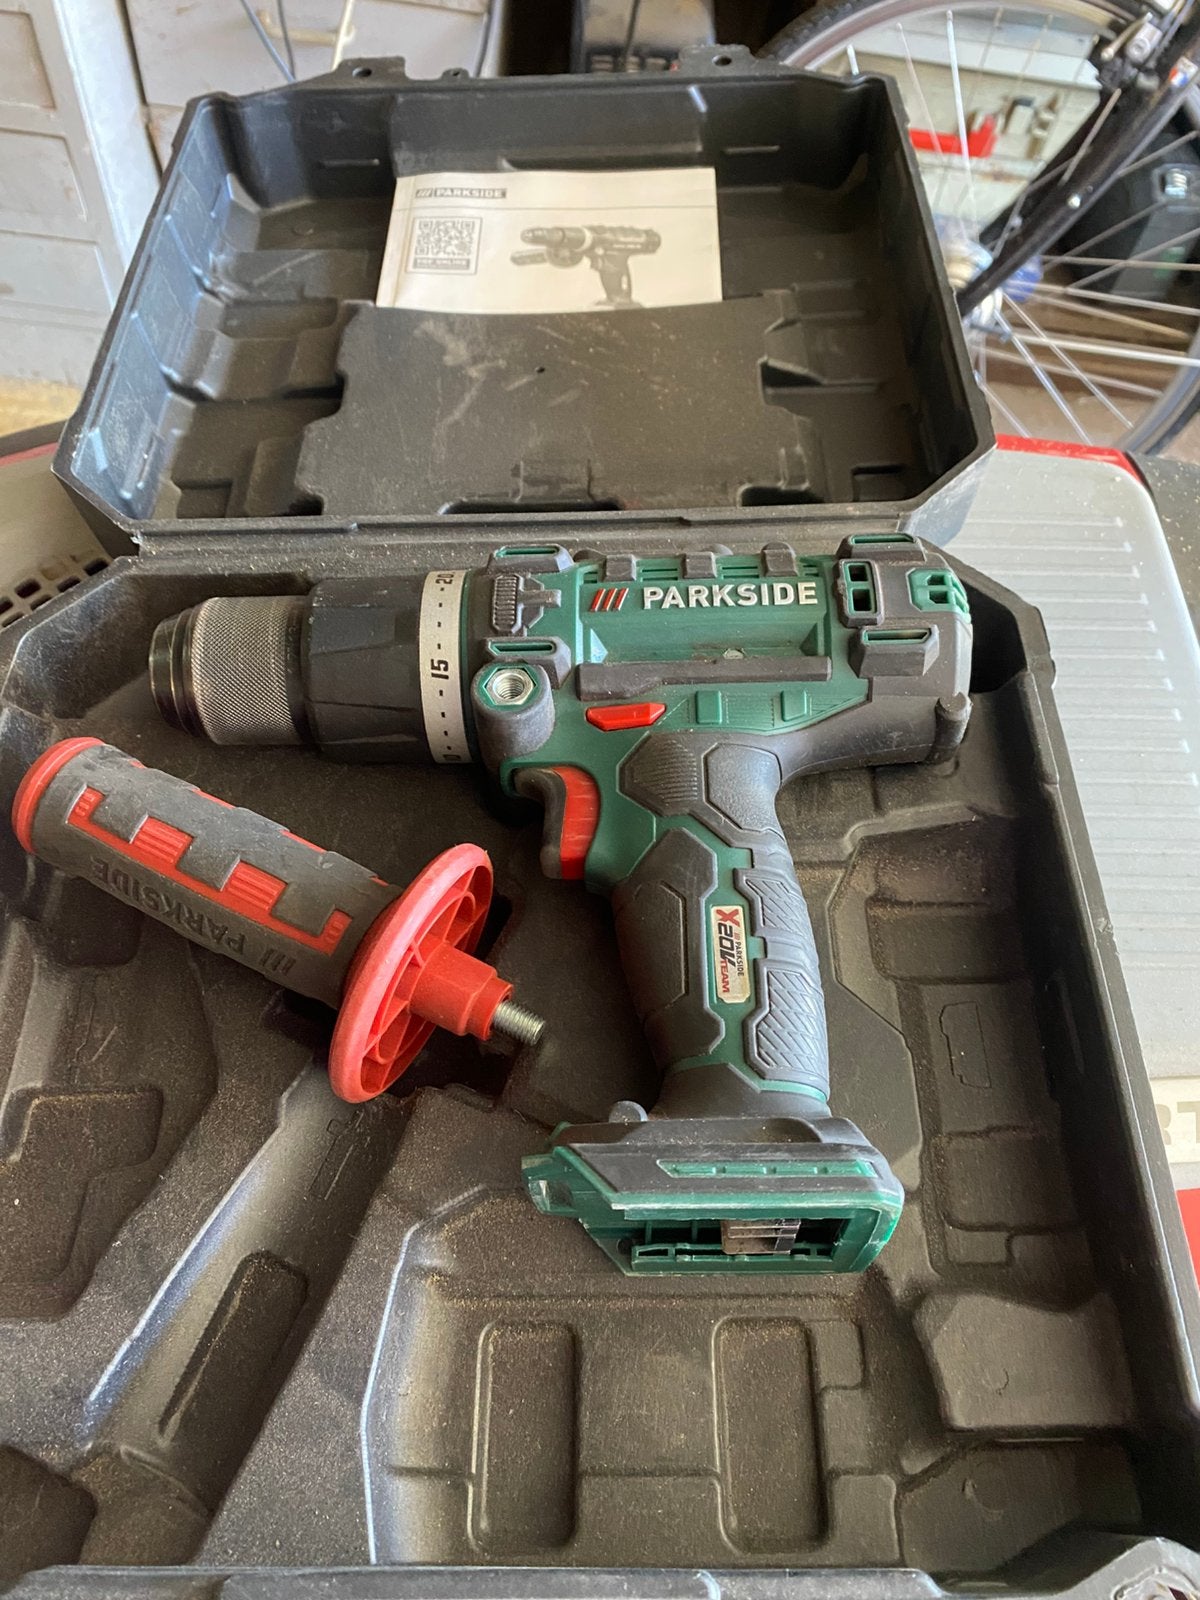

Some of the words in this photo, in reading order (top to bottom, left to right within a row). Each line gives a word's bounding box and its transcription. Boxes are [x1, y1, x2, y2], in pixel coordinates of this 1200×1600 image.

[435, 187, 503, 198] PARKSIDE
[435, 573, 454, 584] 20
[643, 582, 818, 609] PARKSIDE
[430, 659, 449, 680] 15
[91, 855, 247, 954] PARKSIDE
[735, 941, 744, 977] PARKSIDE
[721, 960, 730, 993] TEAM
